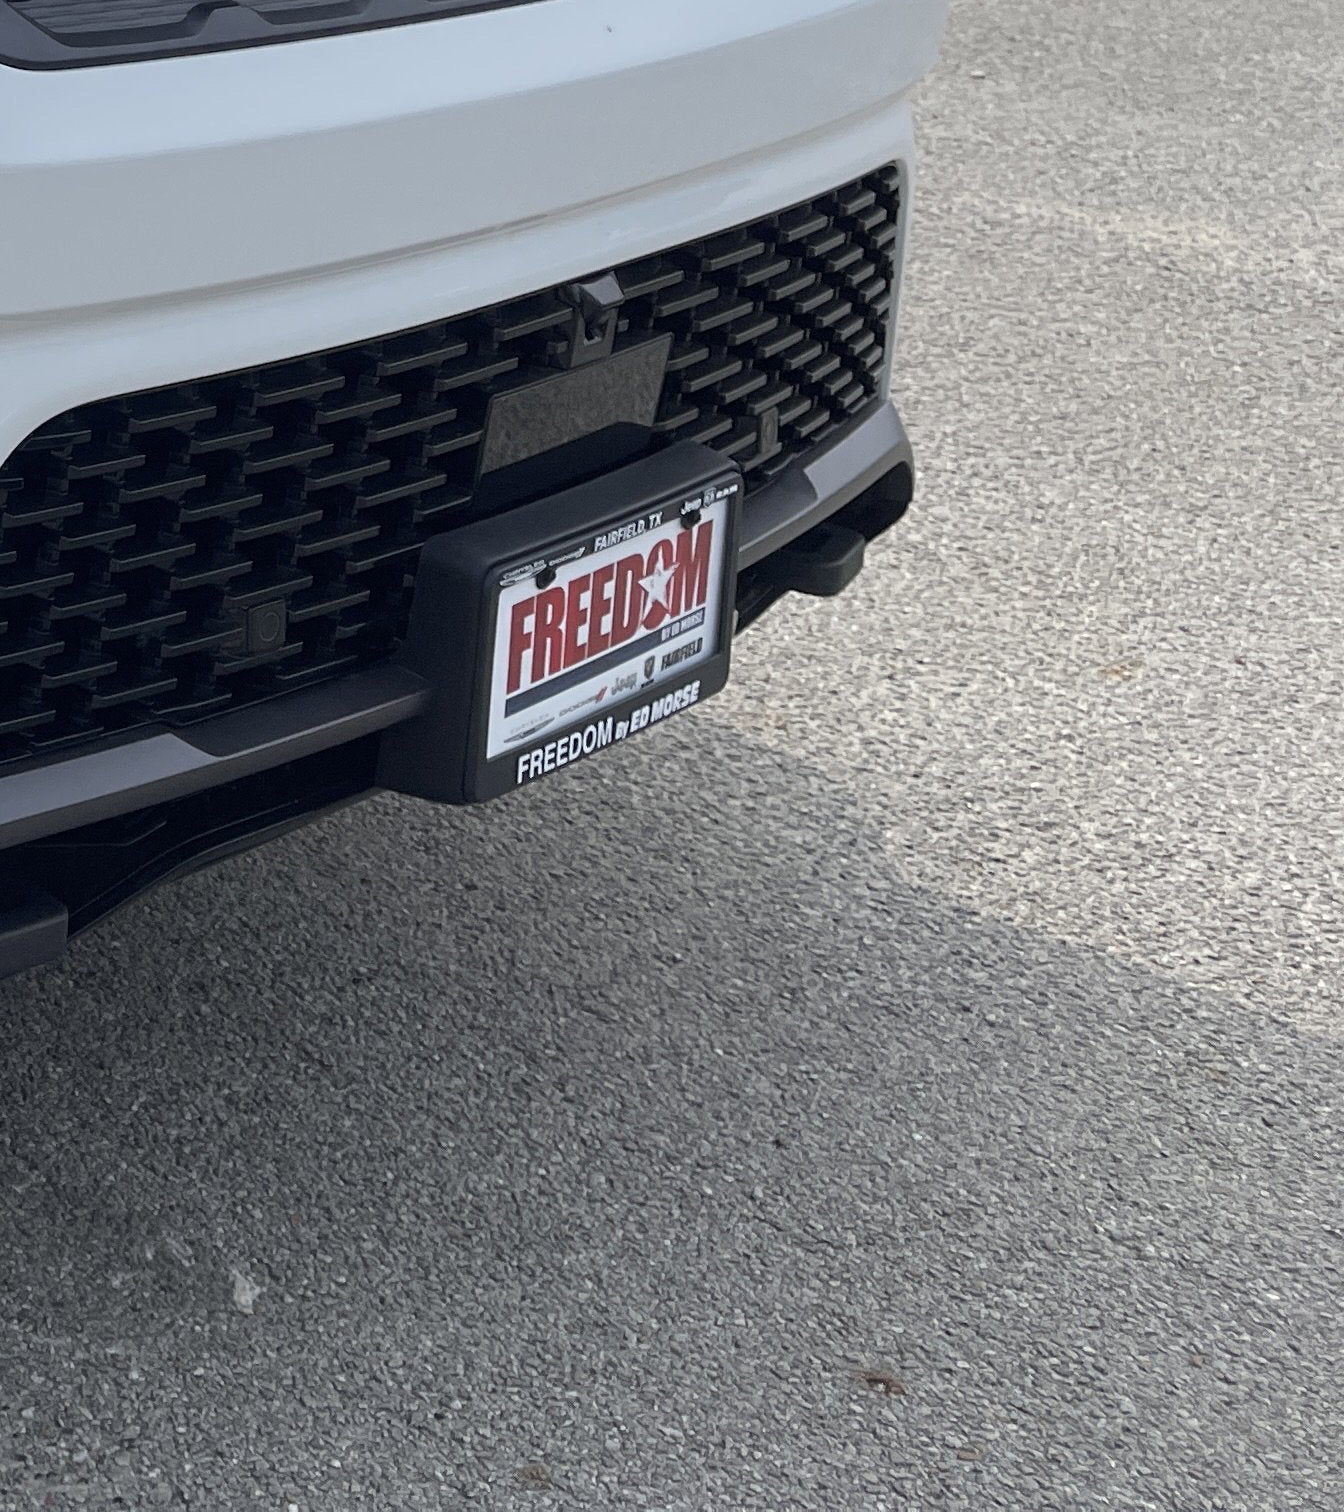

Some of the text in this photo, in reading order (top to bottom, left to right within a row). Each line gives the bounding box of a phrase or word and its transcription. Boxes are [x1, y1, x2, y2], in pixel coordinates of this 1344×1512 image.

[648, 511, 663, 529] TX
[506, 519, 714, 696] FREEDOM
[517, 715, 614, 785] FREEDOM
[630, 704, 651, 733] ED
[650, 679, 701, 723] MORSE
